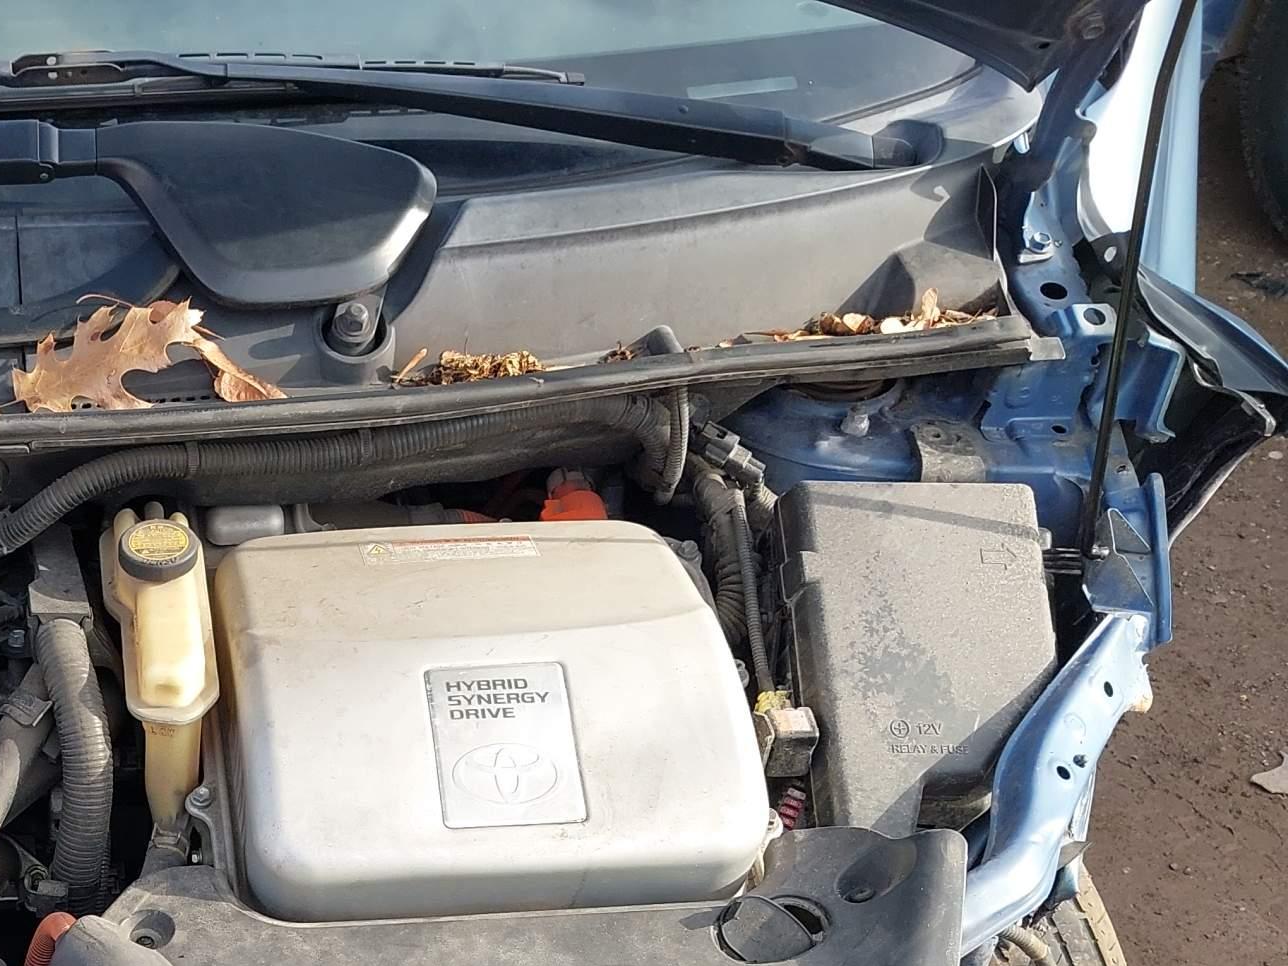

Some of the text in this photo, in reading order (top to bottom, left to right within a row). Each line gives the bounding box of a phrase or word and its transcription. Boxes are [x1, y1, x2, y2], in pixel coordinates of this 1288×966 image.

[445, 678, 529, 692] HYBRID
[447, 691, 550, 706] SYNERGY
[449, 707, 516, 720] DRIVE
[915, 722, 943, 736] 12V
[890, 743, 969, 756] RELAY & FUSE
